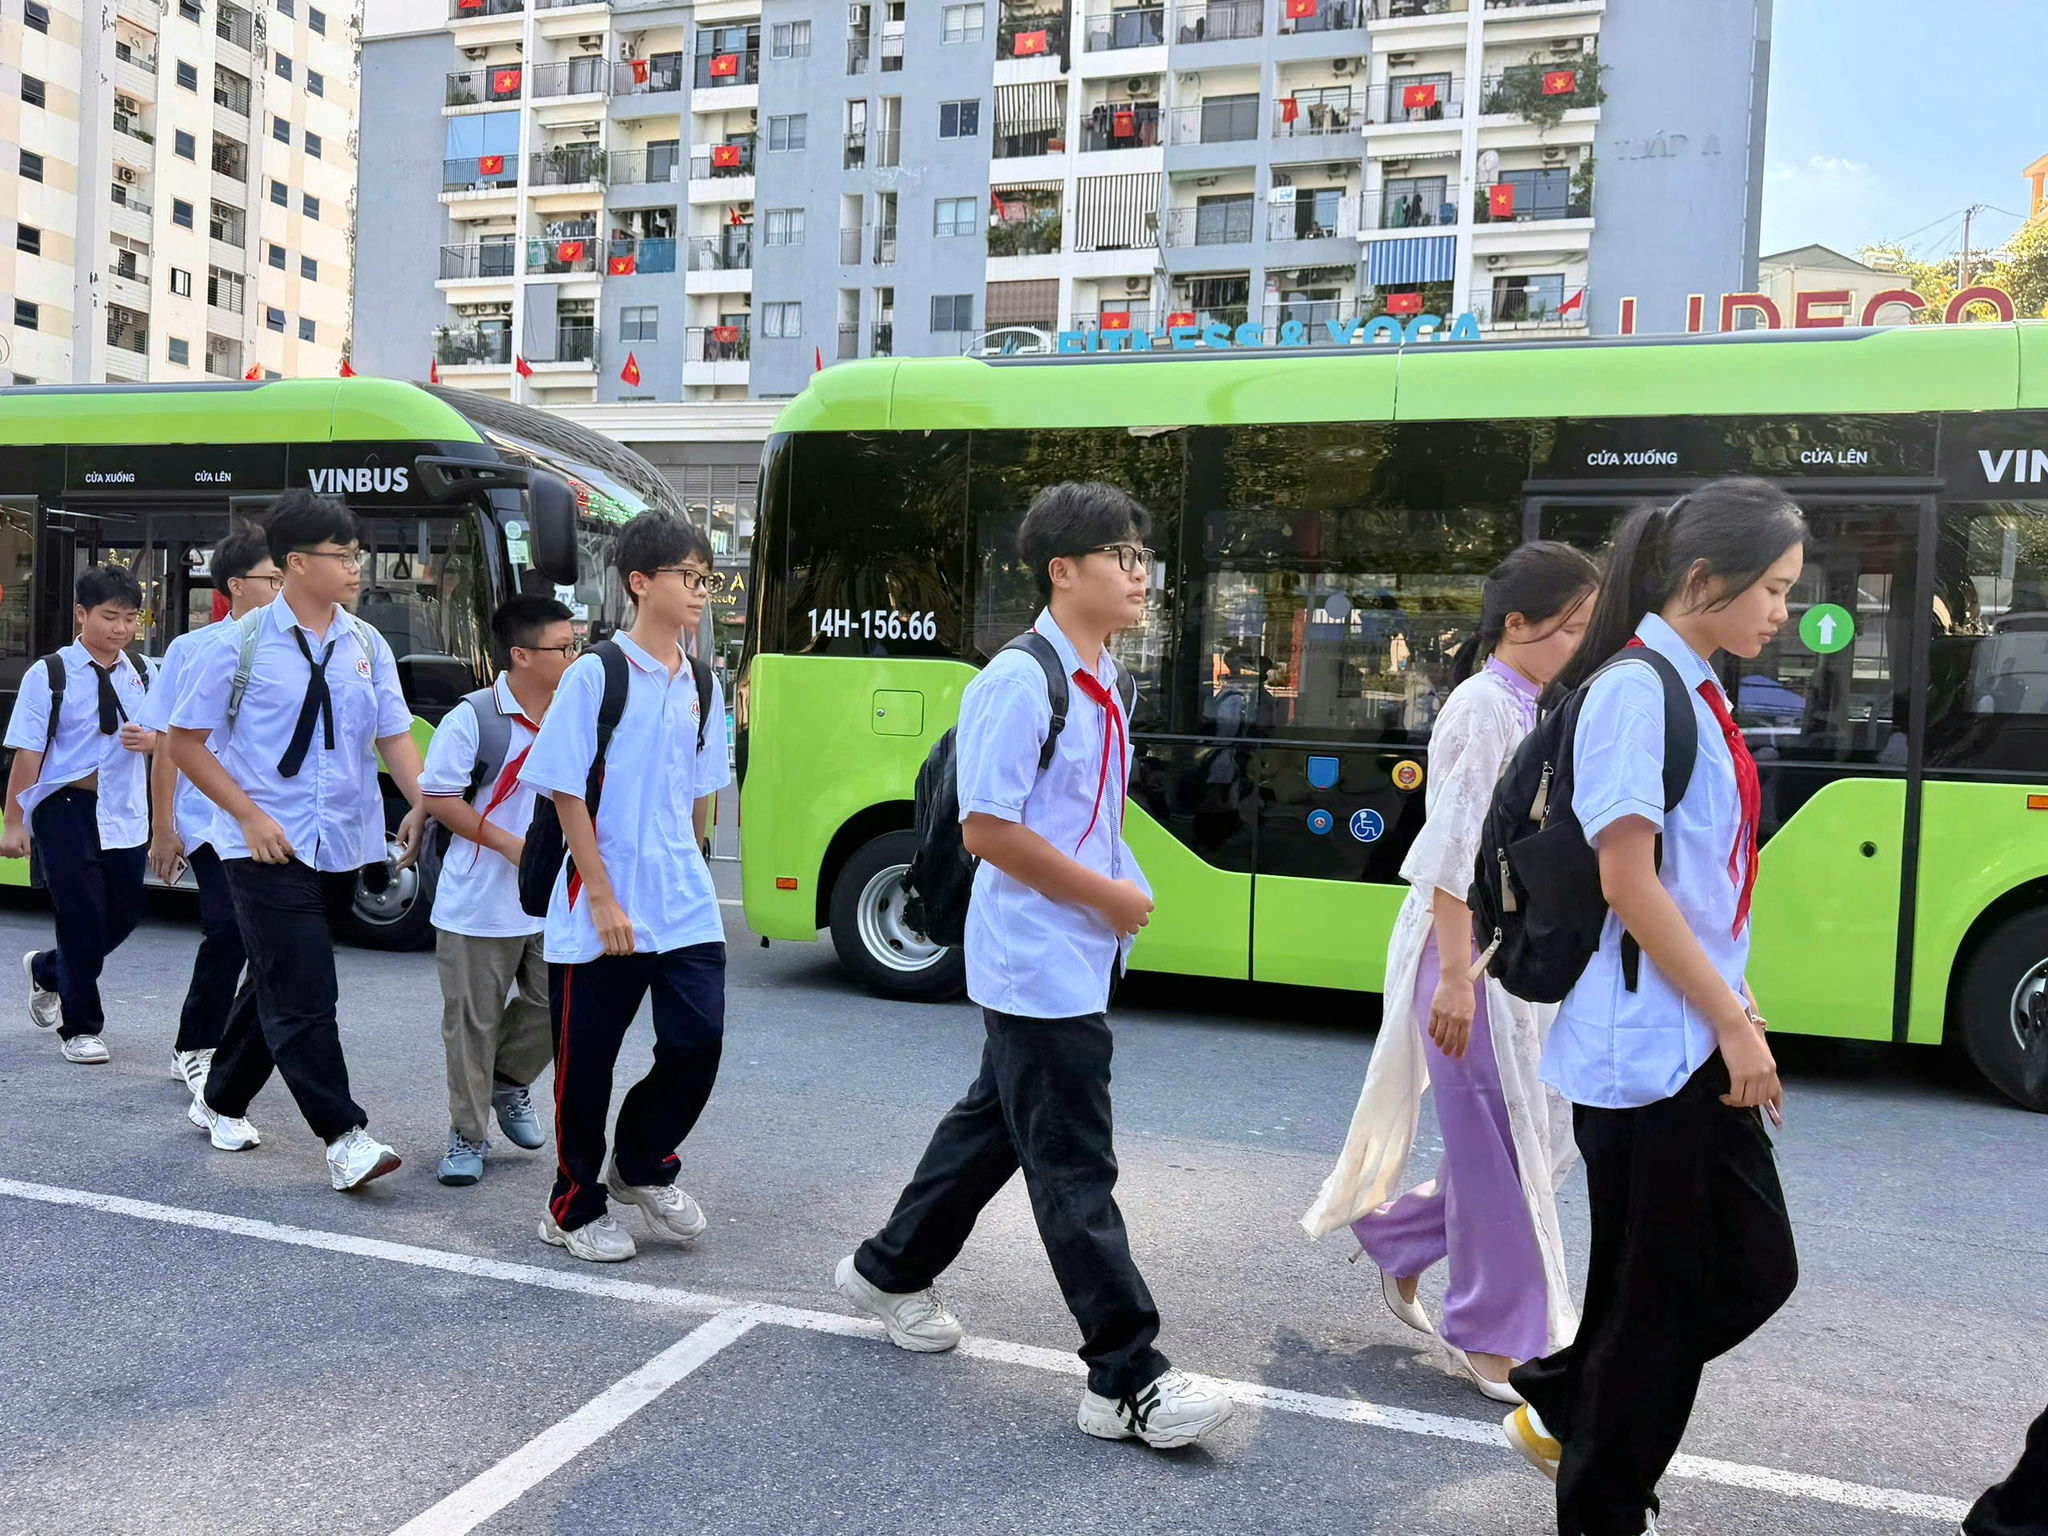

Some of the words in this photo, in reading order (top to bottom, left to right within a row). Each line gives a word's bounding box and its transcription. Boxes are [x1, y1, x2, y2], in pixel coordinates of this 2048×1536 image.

[1623, 448, 1678, 465] XUỐNG
[1838, 448, 1868, 464] LÊN
[214, 470, 232, 482] LÊN
[307, 466, 409, 493] VINBUS
[808, 608, 937, 641] 14H-156.66
